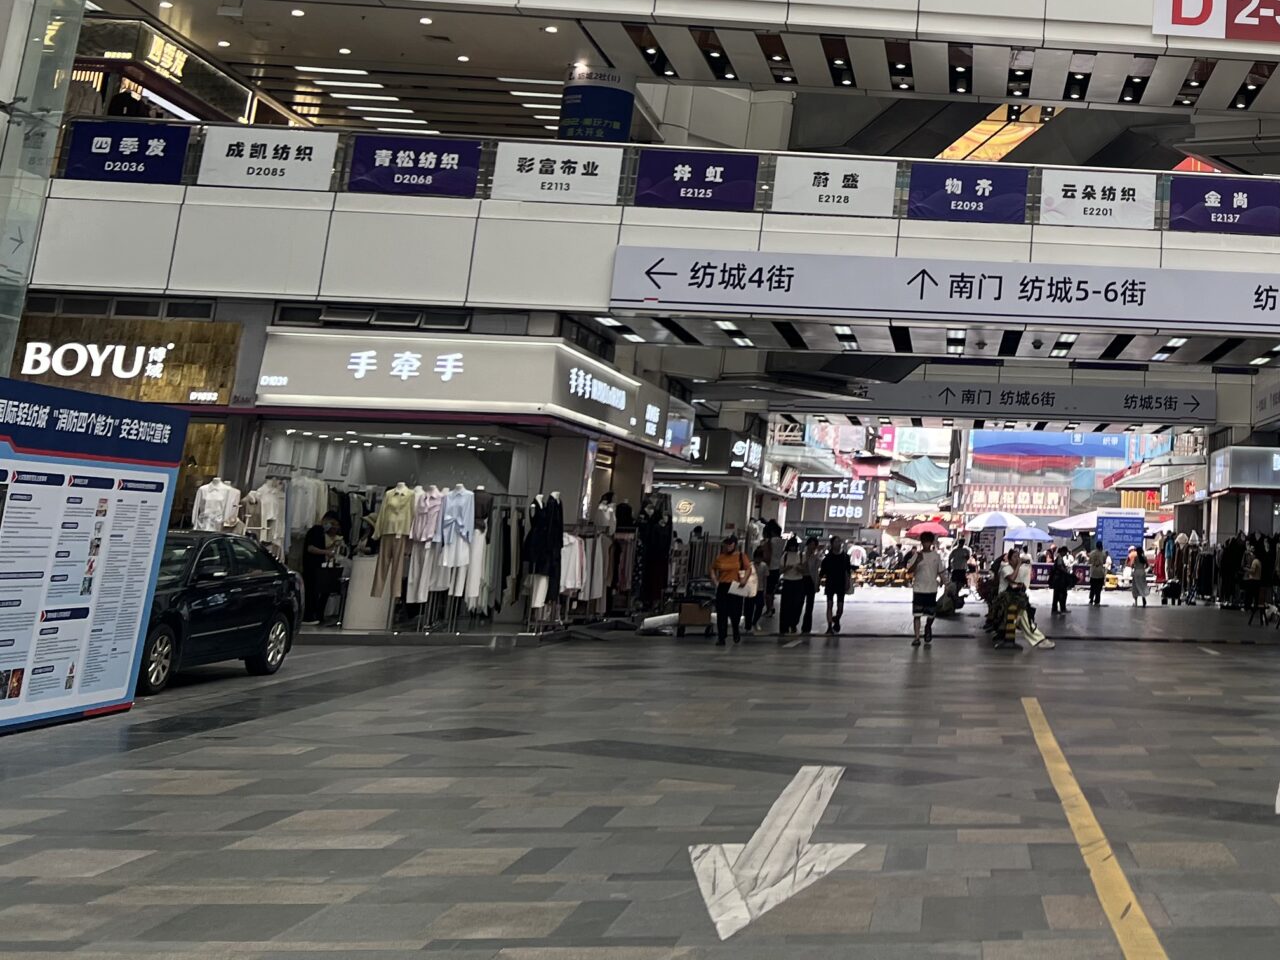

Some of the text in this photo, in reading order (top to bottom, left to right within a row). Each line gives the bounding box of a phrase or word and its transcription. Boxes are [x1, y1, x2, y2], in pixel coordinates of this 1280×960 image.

[91, 135, 166, 157] 四季发
[225, 142, 314, 162] 成凯纺织
[104, 161, 145, 172] D2036
[374, 148, 460, 169] 青松纺织
[516, 156, 599, 176] 彩富布业
[246, 166, 286, 177] D2085
[393, 173, 433, 186] D2068
[540, 181, 571, 192] E2113
[679, 187, 713, 198] E2125
[1061, 183, 1136, 202] 云朵纺织
[818, 193, 851, 205] E2128
[950, 200, 984, 211] E2093
[1204, 191, 1249, 209] 金尚
[1083, 206, 1113, 217] E2201
[1211, 212, 1240, 223] E2137
[688, 262, 795, 293] 纺城4街
[949, 273, 1146, 306] 南门 纺城5-6街
[21, 342, 146, 379] BOYU
[347, 349, 465, 382] 手牵手
[961, 388, 1056, 407] 南门 纺城6街
[1123, 394, 1179, 411] 纺城5街
[119, 417, 171, 445] 安全知识宣传
